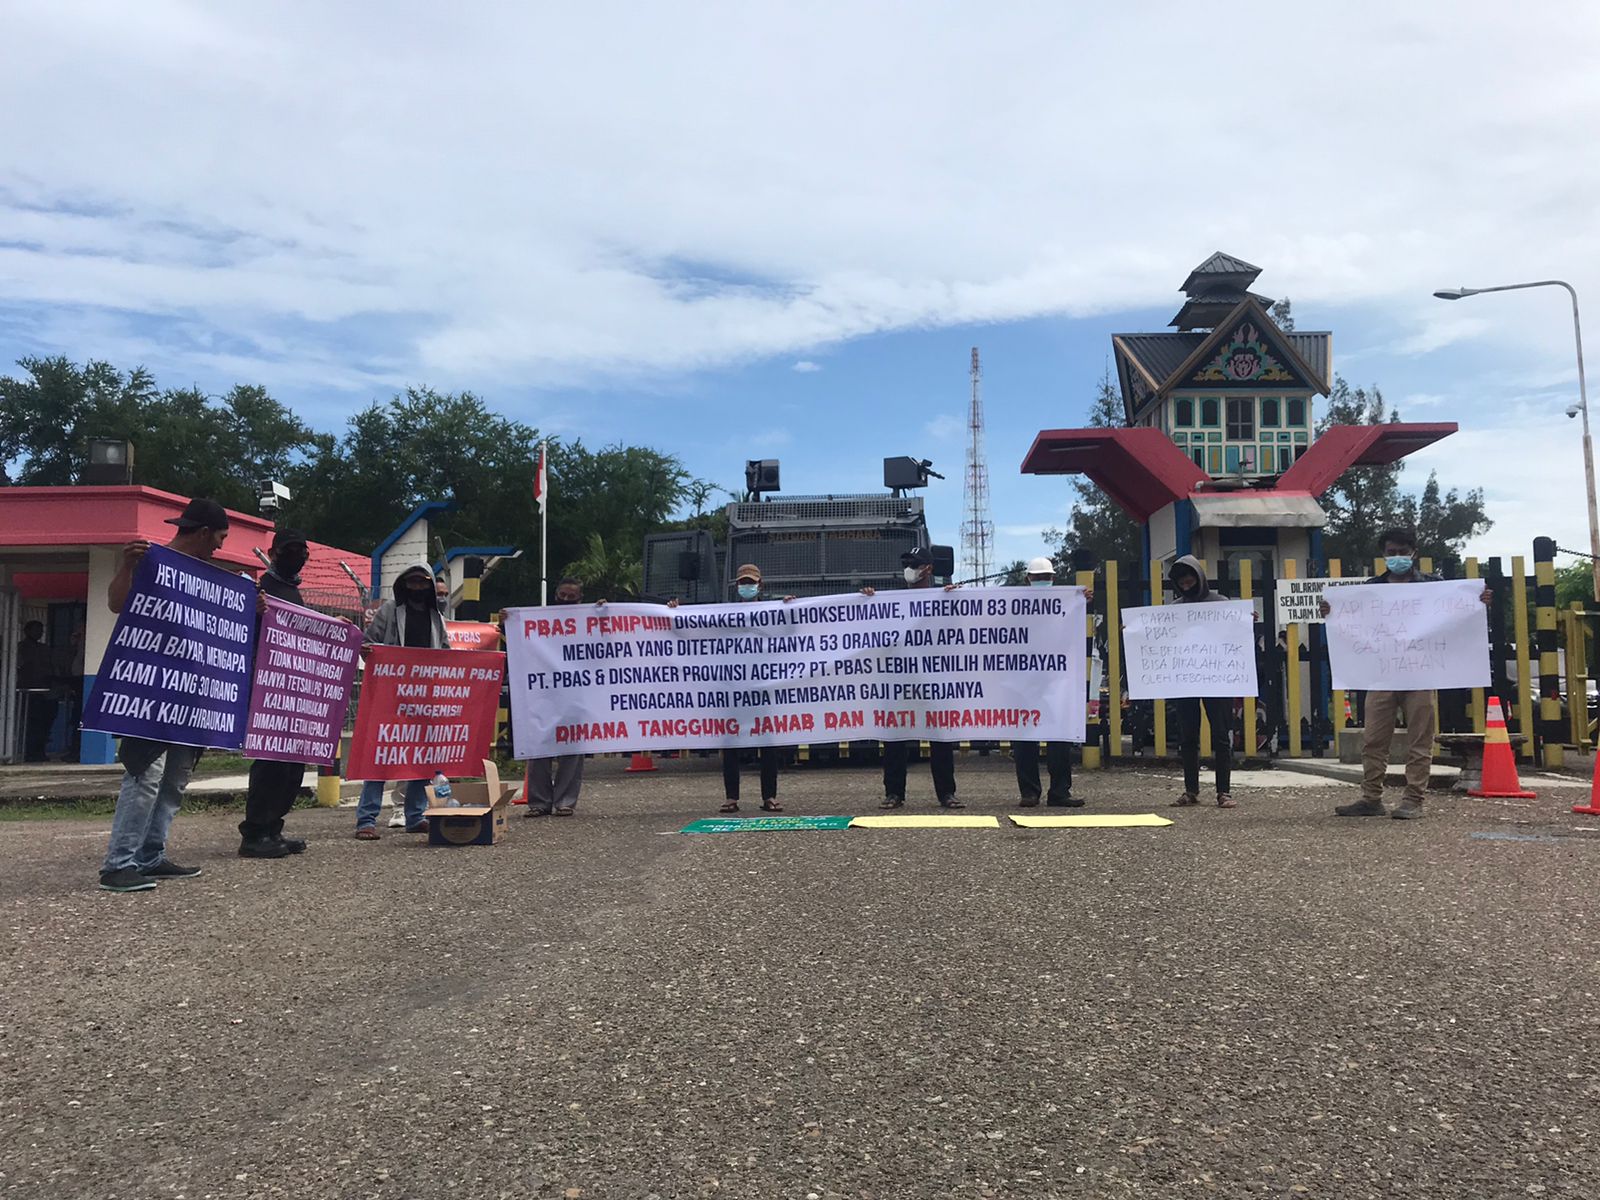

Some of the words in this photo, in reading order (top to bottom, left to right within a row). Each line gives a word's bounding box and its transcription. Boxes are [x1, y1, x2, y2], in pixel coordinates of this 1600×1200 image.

[155, 564, 177, 588] HEY
[179, 571, 222, 602] PIMPINAN
[220, 585, 245, 613] PBAS
[1280, 595, 1313, 607] SENJATA
[130, 593, 182, 627] REKAN
[184, 608, 206, 629] KAMI
[206, 616, 217, 635] 53
[218, 620, 248, 644] ORANG
[524, 618, 577, 639] PBAS
[587, 615, 672, 635] PENIPU!!!!
[675, 612, 745, 629] DISNAKER
[749, 608, 787, 626] KOTA
[790, 602, 905, 624] LHOKSEUMAWE,
[910, 600, 983, 618] MEREKOM
[987, 598, 1006, 616] 83
[1011, 598, 1066, 617] ORANG,
[1187, 609, 1243, 622] PIMPINAN
[1288, 608, 1313, 619] TAJAM
[276, 610, 288, 626] HAI
[289, 614, 327, 636] PIMPINAN
[326, 624, 348, 642] PBAS
[1145, 626, 1177, 640] PBAS
[266, 627, 297, 649] TETESAN
[298, 636, 331, 658] KERINGAT
[330, 645, 353, 663] KAMI
[458, 632, 481, 643] PBAS
[563, 642, 632, 661] MENGAPA
[636, 640, 673, 657] YANG
[677, 637, 764, 656] DITETAPKAN
[767, 636, 815, 652] HANYA
[820, 634, 837, 651] 53
[843, 631, 899, 650] ORANG?
[904, 630, 933, 646] ADA
[937, 629, 964, 645] APA
[969, 627, 1028, 645] DENGAN
[1222, 642, 1244, 655] TAK
[115, 626, 160, 651] ANDA
[164, 636, 206, 667] BAYAR,
[206, 651, 245, 674] MENGAPA
[268, 650, 292, 668] TIDAK
[293, 655, 316, 673] KALIAN
[316, 662, 343, 681] HARGAI
[373, 663, 405, 676] HALO
[411, 667, 465, 680] PIMPINAN
[469, 669, 501, 681] PBAS
[528, 673, 549, 690] PT.
[553, 671, 591, 688] PBAS
[595, 669, 605, 685] &
[609, 666, 679, 684] DISNAKER
[683, 664, 746, 682] PROVINSI
[750, 662, 805, 680] ACEH??
[809, 661, 830, 678] PT.
[835, 658, 872, 676] PBAS
[877, 656, 918, 674] LEBIH
[922, 655, 978, 673] NENILIH
[982, 654, 1067, 672] MEMBAYAR
[1141, 659, 1168, 670] BISA
[109, 659, 156, 685] KAMI
[161, 668, 198, 692] YANG
[198, 676, 211, 696] 30
[211, 679, 238, 703] ORANG
[257, 670, 286, 689] HANYA
[287, 675, 311, 695] TETSAN
[323, 684, 344, 700] YANG
[1141, 674, 1171, 685] OLEH
[1176, 674, 1249, 684] KEBOHONGAN
[263, 692, 296, 712] KALIAN
[397, 685, 427, 697] KAMI
[433, 686, 470, 698] BUKAN
[610, 692, 694, 711] PENGACARA
[698, 691, 729, 708] DARI
[733, 690, 770, 707] PADA
[774, 684, 856, 705] MEMBAYAR
[860, 683, 889, 700] GAJI
[894, 681, 983, 700] PEKERJANYA
[100, 692, 154, 719] TIDAK
[156, 702, 188, 726] KAU
[191, 709, 234, 733] HIRAUKAN
[397, 704, 463, 718] PENGEMIS!!
[252, 713, 288, 731] DIMANA
[290, 717, 308, 735] LETAK
[308, 721, 330, 738] KEPALA
[378, 724, 421, 743] KAMI
[424, 725, 469, 742] MINTA
[555, 721, 628, 744] DIMANA
[638, 718, 740, 737] TANGGUNG
[749, 713, 814, 733] JAWAB
[824, 710, 864, 729] DAN
[874, 710, 915, 728] HATI
[926, 709, 1041, 731] NURANIMU??
[311, 742, 333, 758] PBAS)
[375, 745, 409, 765] HAK
[413, 745, 465, 764] KAMI!!!
